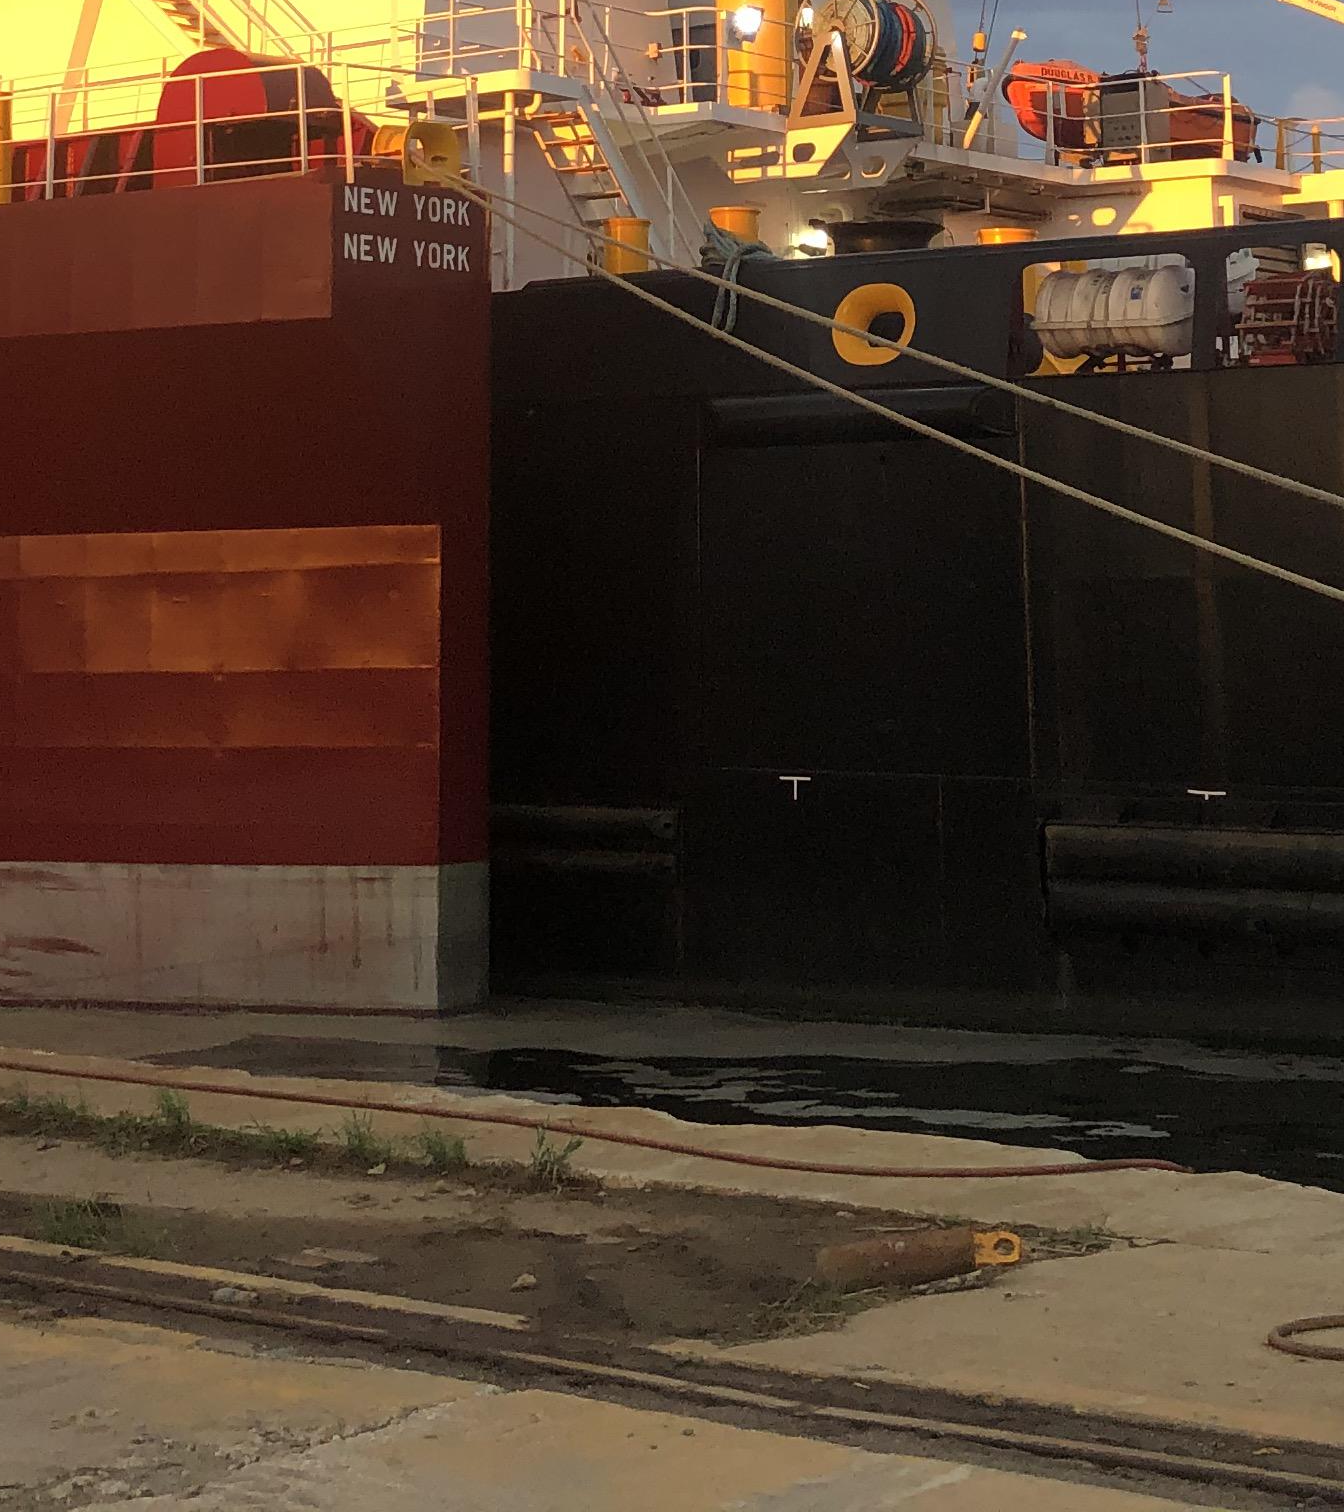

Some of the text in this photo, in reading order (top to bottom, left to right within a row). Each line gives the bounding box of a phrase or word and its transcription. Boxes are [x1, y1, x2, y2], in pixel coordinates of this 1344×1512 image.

[1041, 67, 1086, 82] DOUGLAS
[343, 186, 471, 227] NEW YORK
[343, 232, 471, 272] NEW YORK
